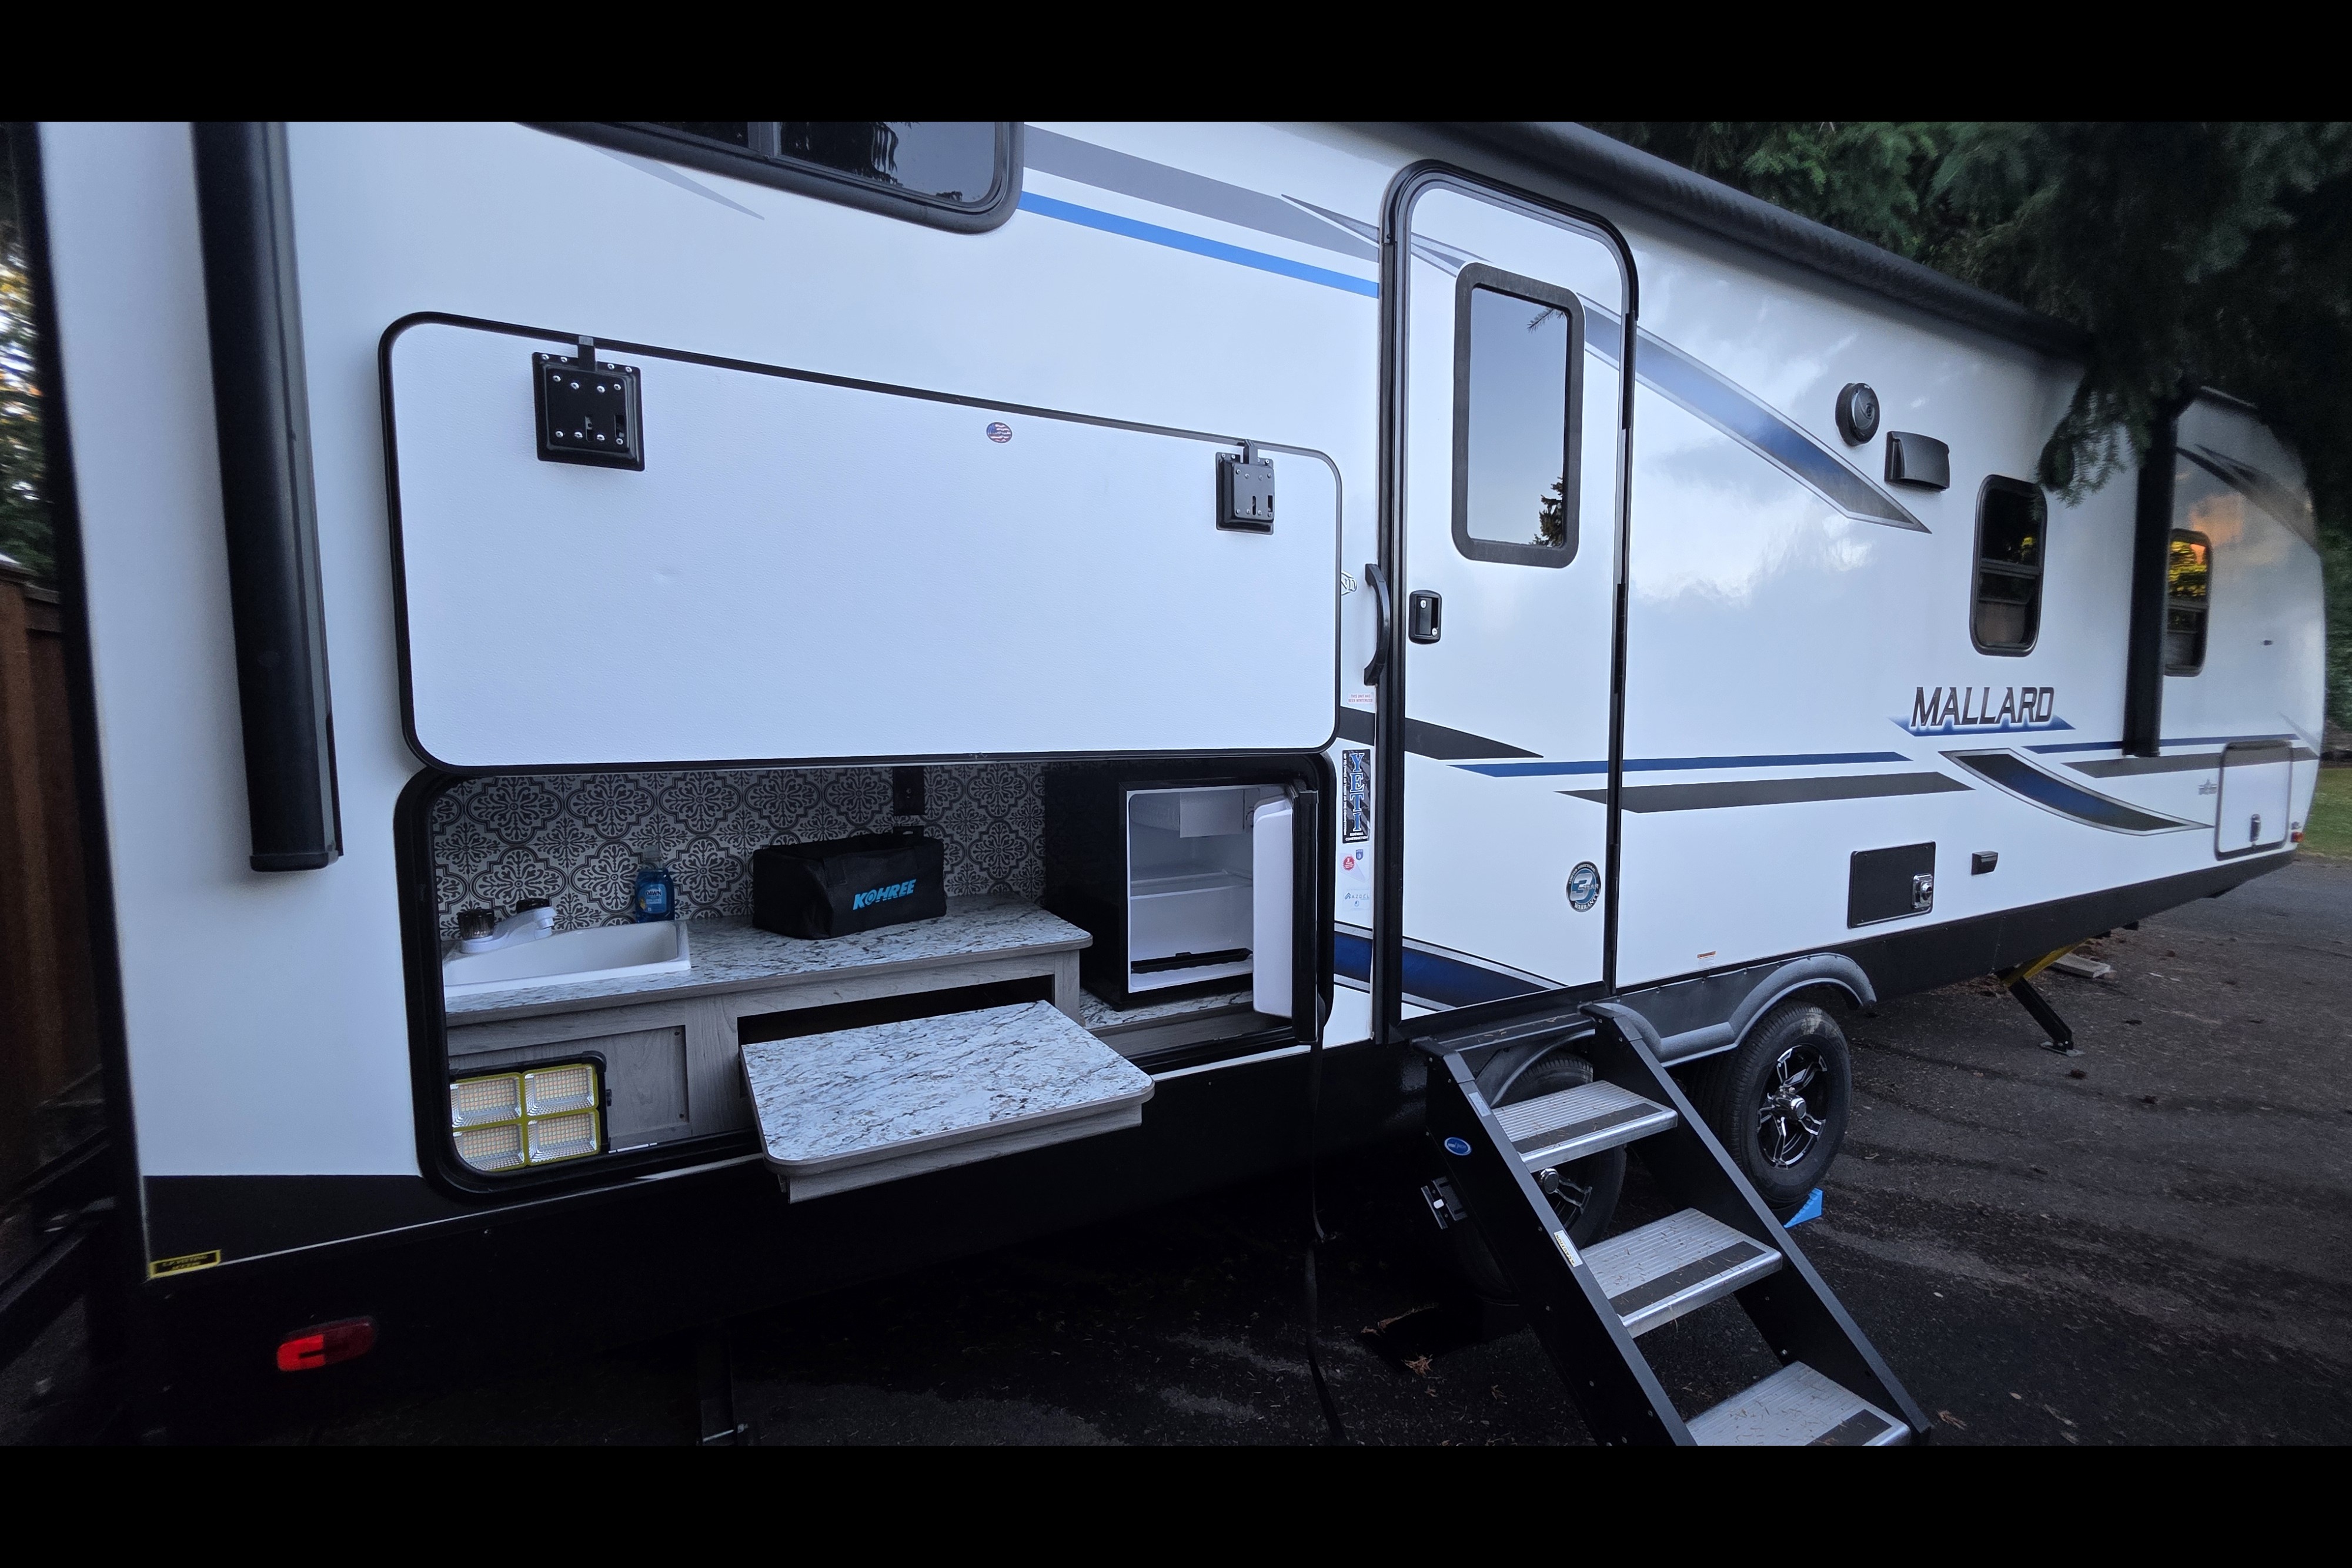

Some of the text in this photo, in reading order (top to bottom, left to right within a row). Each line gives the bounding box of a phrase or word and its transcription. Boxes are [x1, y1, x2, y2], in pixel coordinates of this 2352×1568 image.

[1911, 687, 2054, 727] MALLARD
[1349, 753, 1364, 831] YETI
[853, 879, 916, 910] KOHREE
[1570, 873, 1592, 901] 3
[1574, 891, 1599, 910] WARRANTY
[1556, 1235, 1572, 1259] CAUTION
